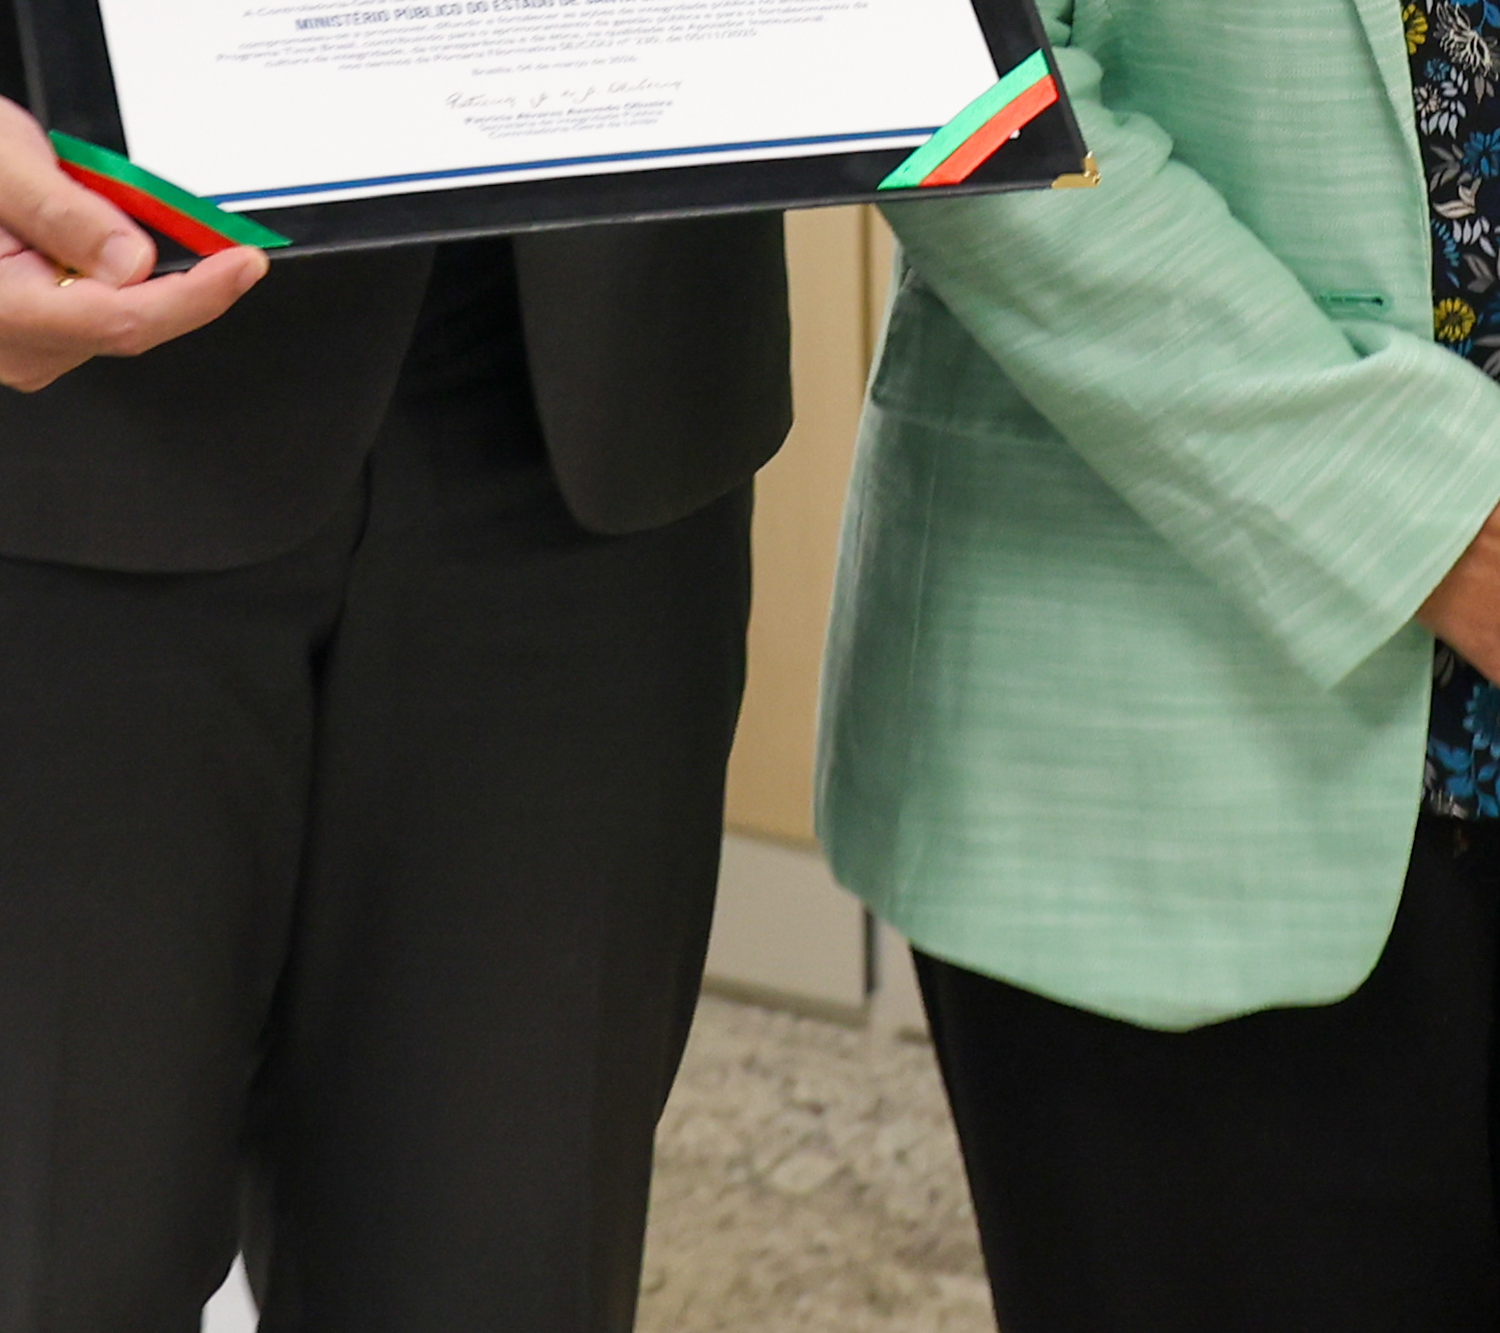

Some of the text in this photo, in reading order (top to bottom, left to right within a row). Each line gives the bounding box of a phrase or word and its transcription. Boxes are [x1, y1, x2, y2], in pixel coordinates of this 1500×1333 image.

[295, 10, 390, 30] MINISTÉRIO
[393, 3, 463, 20] PÚBLICO
[466, 0, 489, 14] DO
